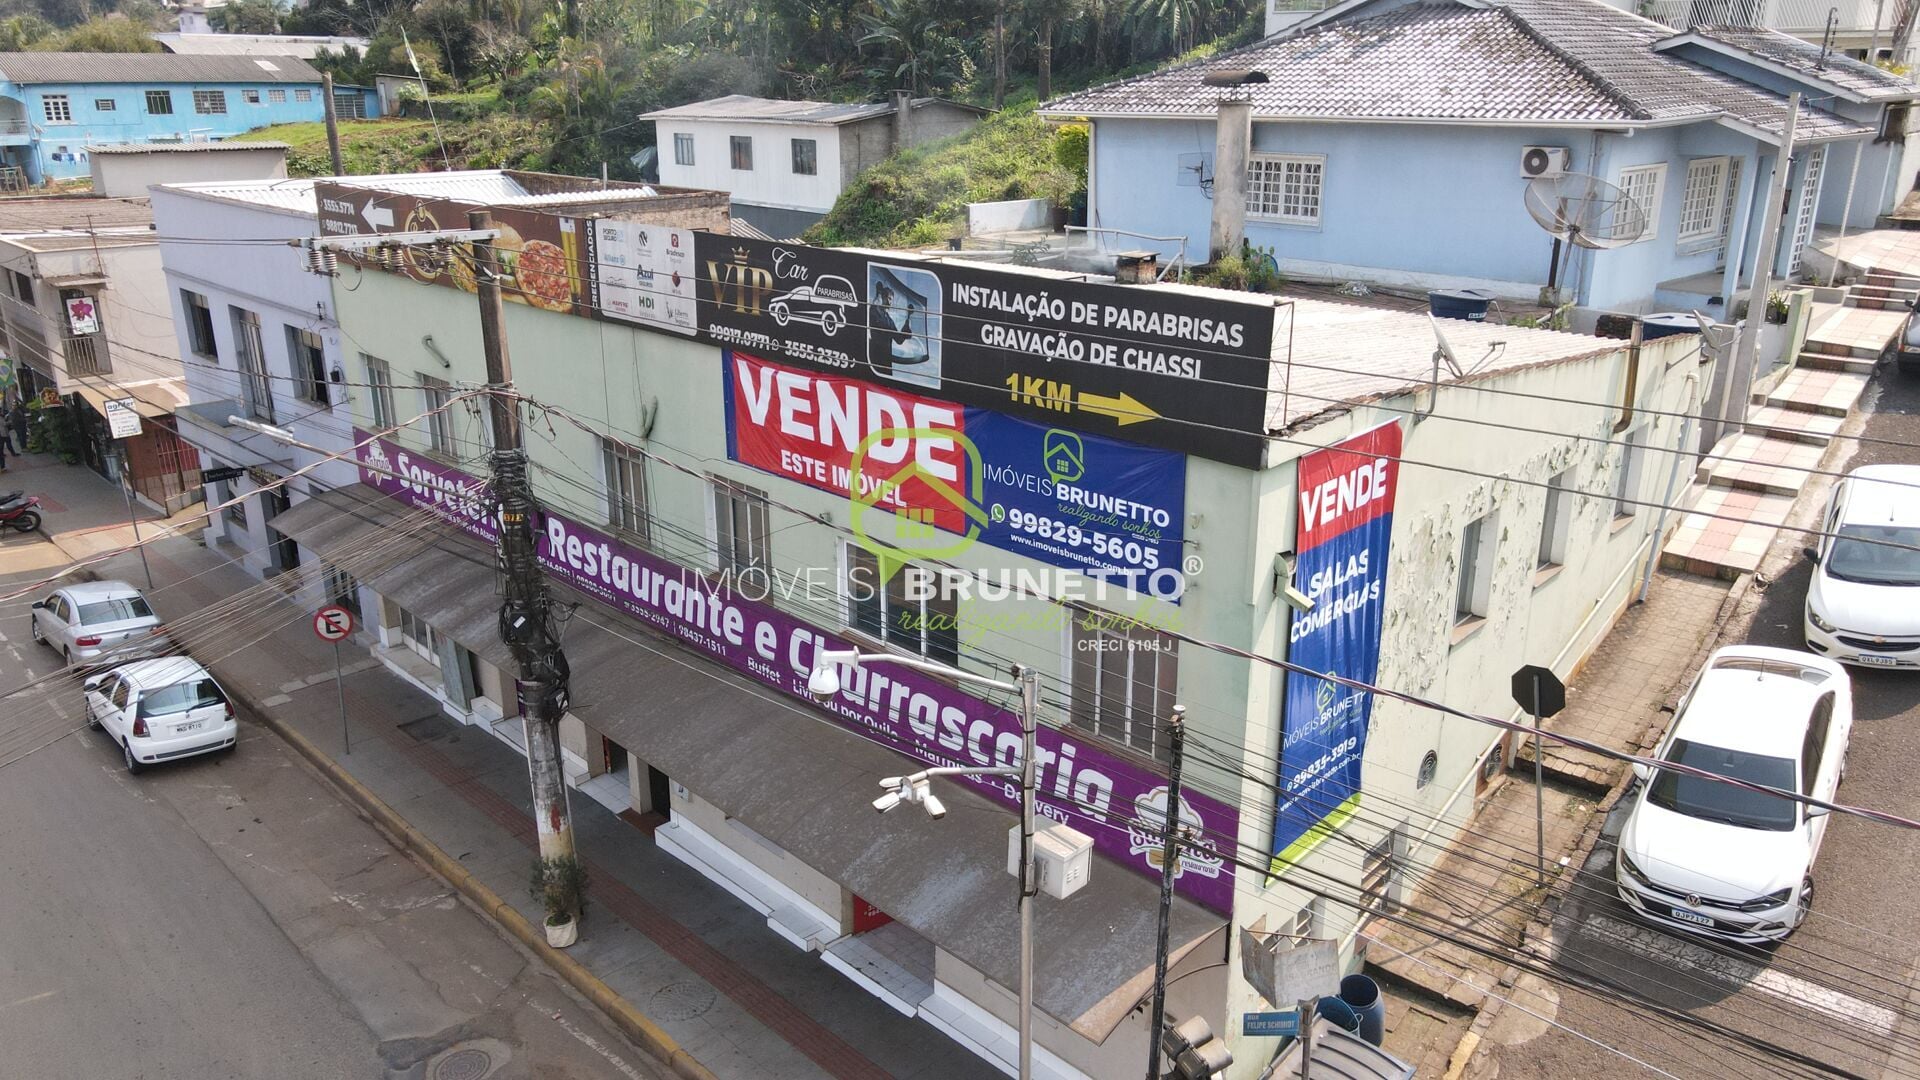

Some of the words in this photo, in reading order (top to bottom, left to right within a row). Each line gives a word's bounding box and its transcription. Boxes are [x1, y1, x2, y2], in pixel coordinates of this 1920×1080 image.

[706, 260, 774, 317] VIP
[771, 246, 809, 282] Car
[638, 295, 655, 310] HDI
[817, 287, 854, 302] PARABRISAS
[952, 282, 1066, 322] INSTALAÇÃO
[1071, 301, 1099, 327] DE
[1104, 306, 1245, 348] PARABRISAS
[980, 324, 1084, 362] GRAVAÇÃO
[1089, 342, 1118, 367] DE
[1122, 349, 1201, 380] CHASSI
[735, 358, 958, 482] VENDE
[1005, 372, 1072, 414] 1KM
[780, 449, 827, 483] ESTE
[832, 464, 907, 507] IMÓVEL
[983, 462, 1053, 497] IMÓVEIS
[1056, 483, 1171, 528] BRUNETTO
[1301, 456, 1389, 533] VENDE
[1008, 508, 1160, 570] 99829-5605
[1010, 533, 1133, 577] www.imoveisbrunetto.com.br
[547, 516, 745, 647] Restaurante
[754, 620, 778, 661] e
[1309, 548, 1370, 599] SALAS
[325, 612, 344, 634] E
[678, 623, 728, 657] 98437-1511
[747, 656, 782, 685] Buffet
[1003, 782, 1070, 828] Devery
[1246, 1020, 1266, 1030] FELIPE
